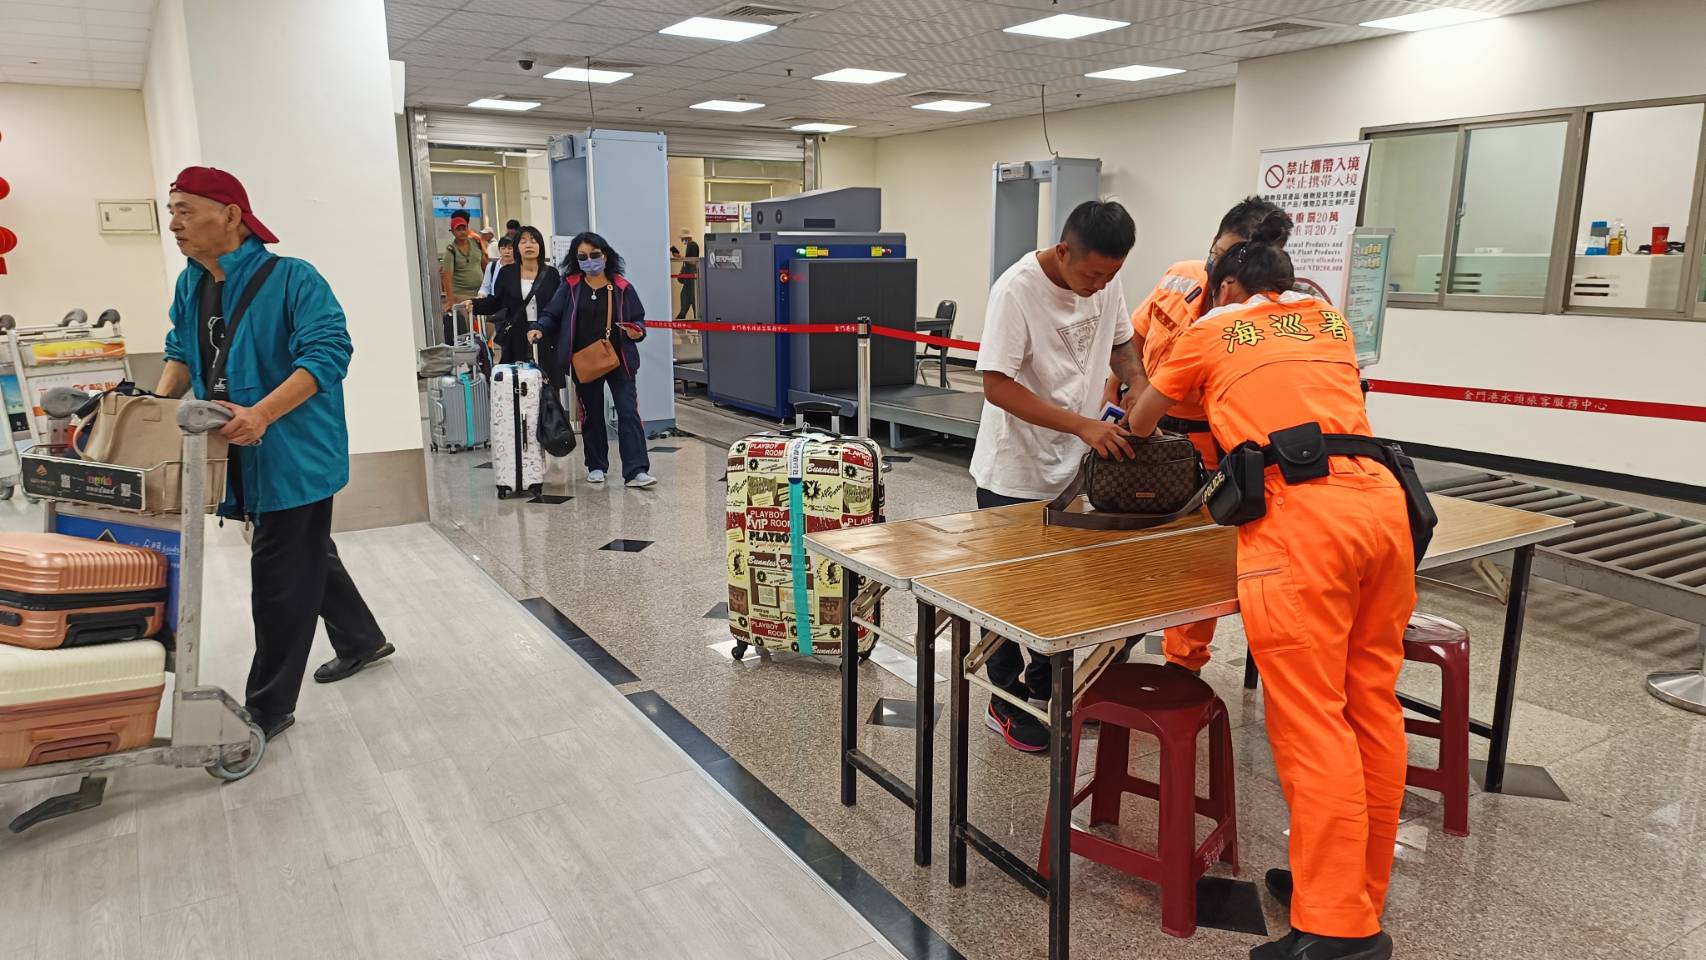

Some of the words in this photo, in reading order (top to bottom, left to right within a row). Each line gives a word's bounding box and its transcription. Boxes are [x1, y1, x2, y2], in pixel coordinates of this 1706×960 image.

[1286, 156, 1360, 175] 禁止攜帶入境
[1286, 173, 1358, 189] 禁止携带入境
[1224, 310, 1350, 353] 海巡署
[1463, 390, 1608, 411] 金門港水頭旅客服務中心
[807, 463, 838, 474] Bunnies
[1203, 471, 1225, 502] POLICE
[750, 510, 785, 519] PLAYBOY
[751, 518, 769, 530] VIP
[748, 531, 791, 544] PLAYBO
[751, 621, 779, 630] PLAYBOY
[767, 629, 786, 637] ROOM
